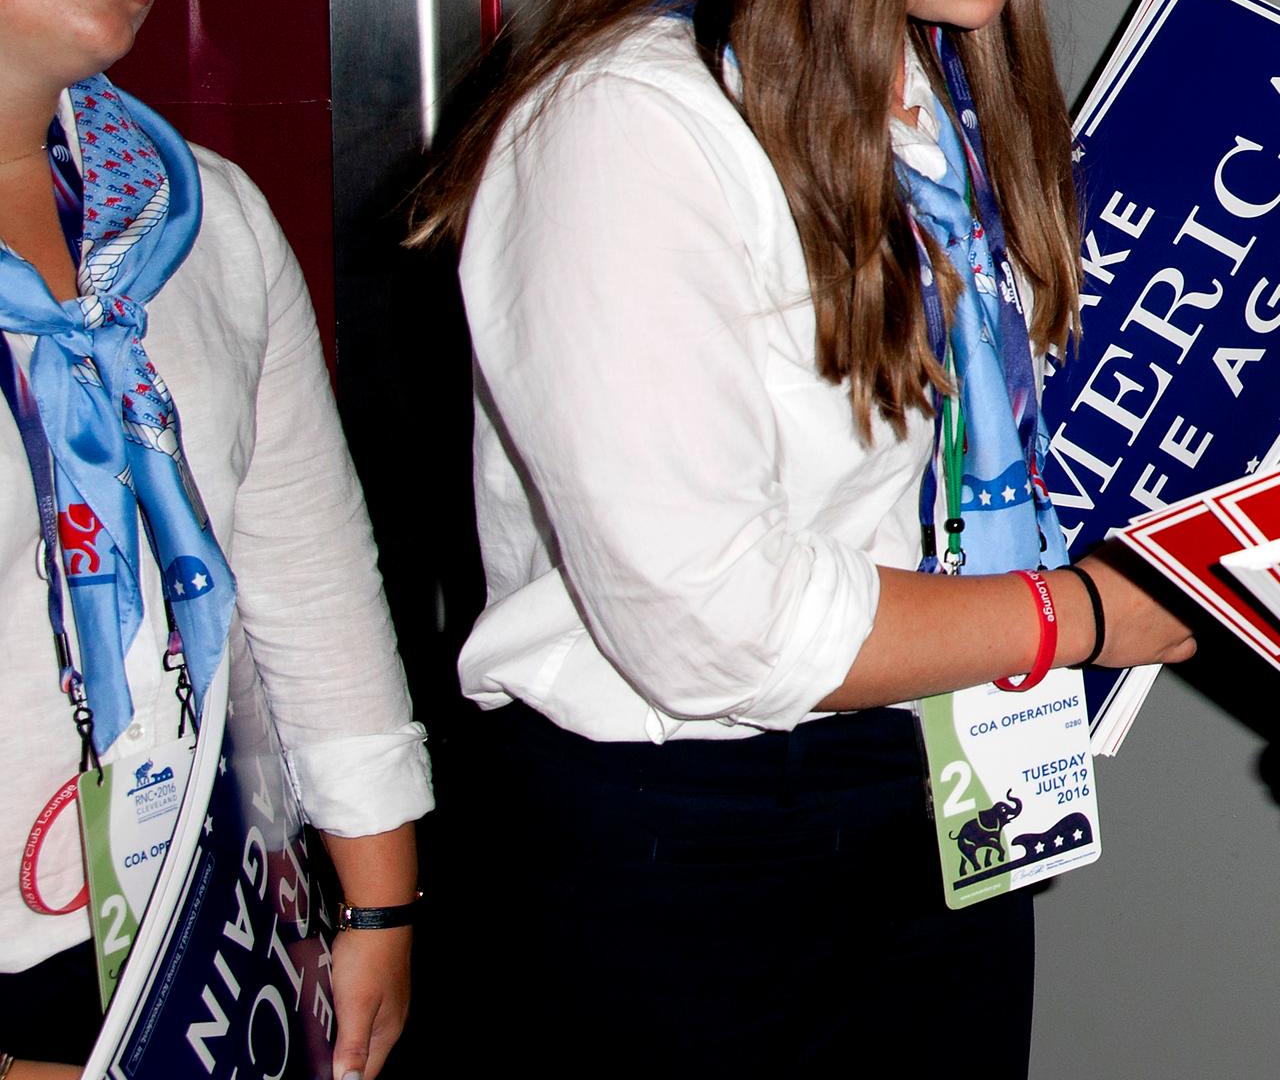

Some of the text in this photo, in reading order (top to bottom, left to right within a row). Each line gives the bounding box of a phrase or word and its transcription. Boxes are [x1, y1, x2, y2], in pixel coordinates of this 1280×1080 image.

[1035, 581, 1056, 623] Lounge
[970, 695, 1080, 737] COA OPERATIONS
[1022, 752, 1087, 783] TUESDAY
[1035, 768, 1088, 796] JULY 19
[38, 783, 77, 825] Lounge
[136, 794, 179, 816] CLEVELAND
[940, 760, 976, 819] 2
[1057, 785, 1090, 805] 2016
[25, 827, 42, 857] Club
[23, 861, 32, 890] RNC
[124, 851, 148, 869] COA
[101, 893, 132, 955] 2
[186, 754, 275, 1075] AGAIN
